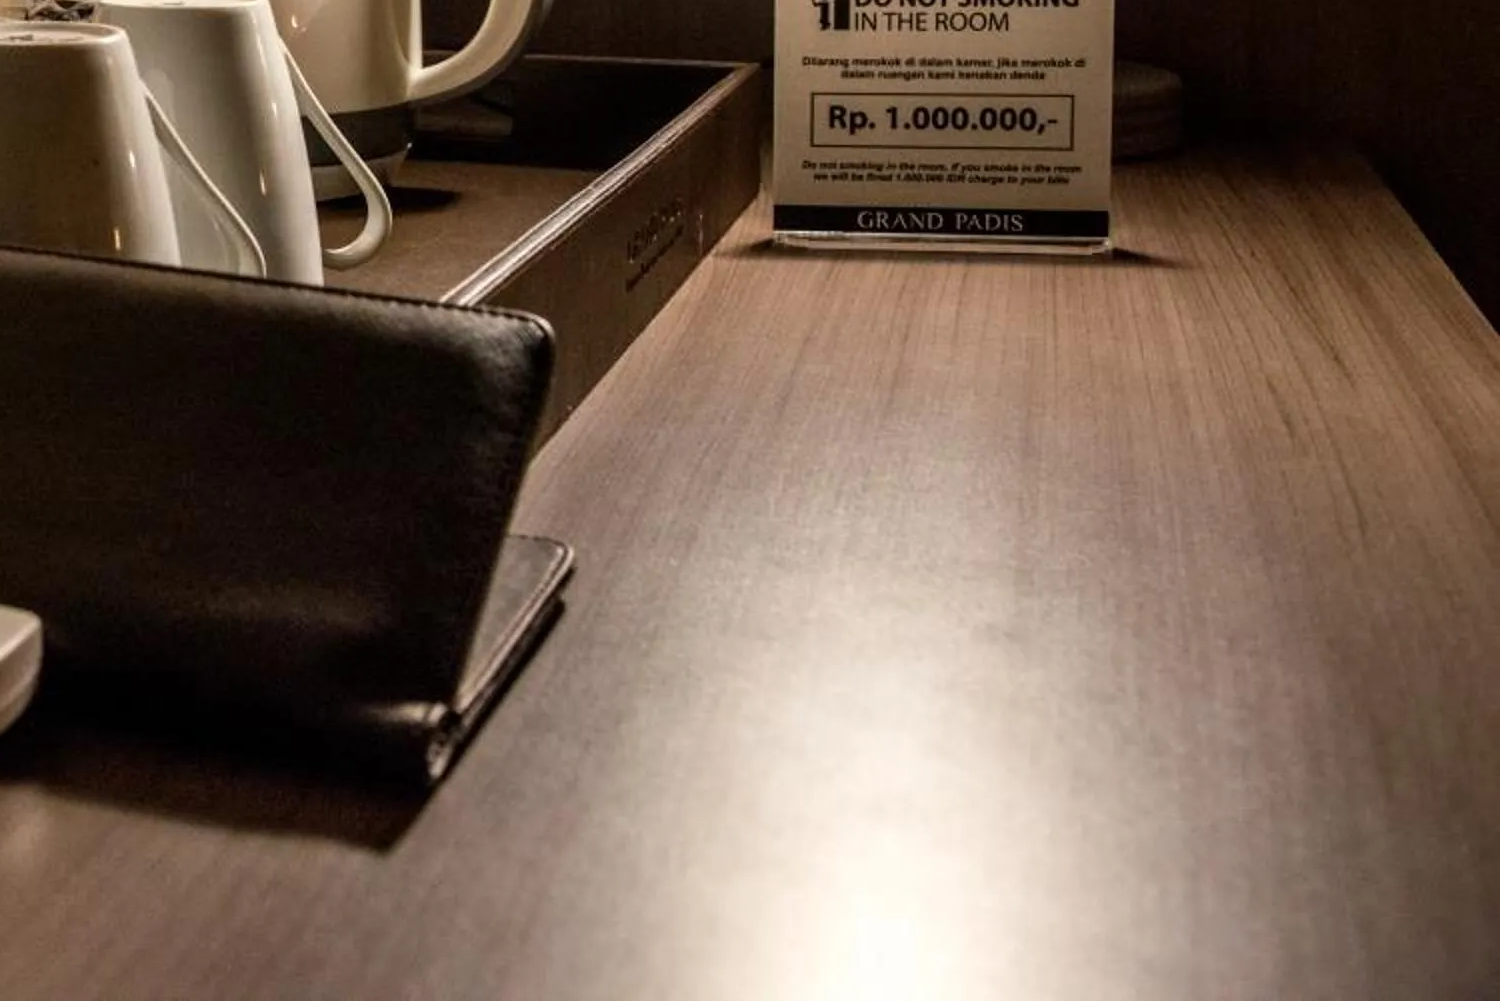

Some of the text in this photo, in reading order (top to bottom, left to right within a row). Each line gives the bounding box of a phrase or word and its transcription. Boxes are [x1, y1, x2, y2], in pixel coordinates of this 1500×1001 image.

[854, 12, 1010, 32] IN THE ROOM
[802, 56, 849, 68] Dilarang
[919, 56, 954, 67] dalam
[828, 105, 1058, 135] Rp. 1.000.000,-
[857, 210, 1024, 232] GRAND PADIS
